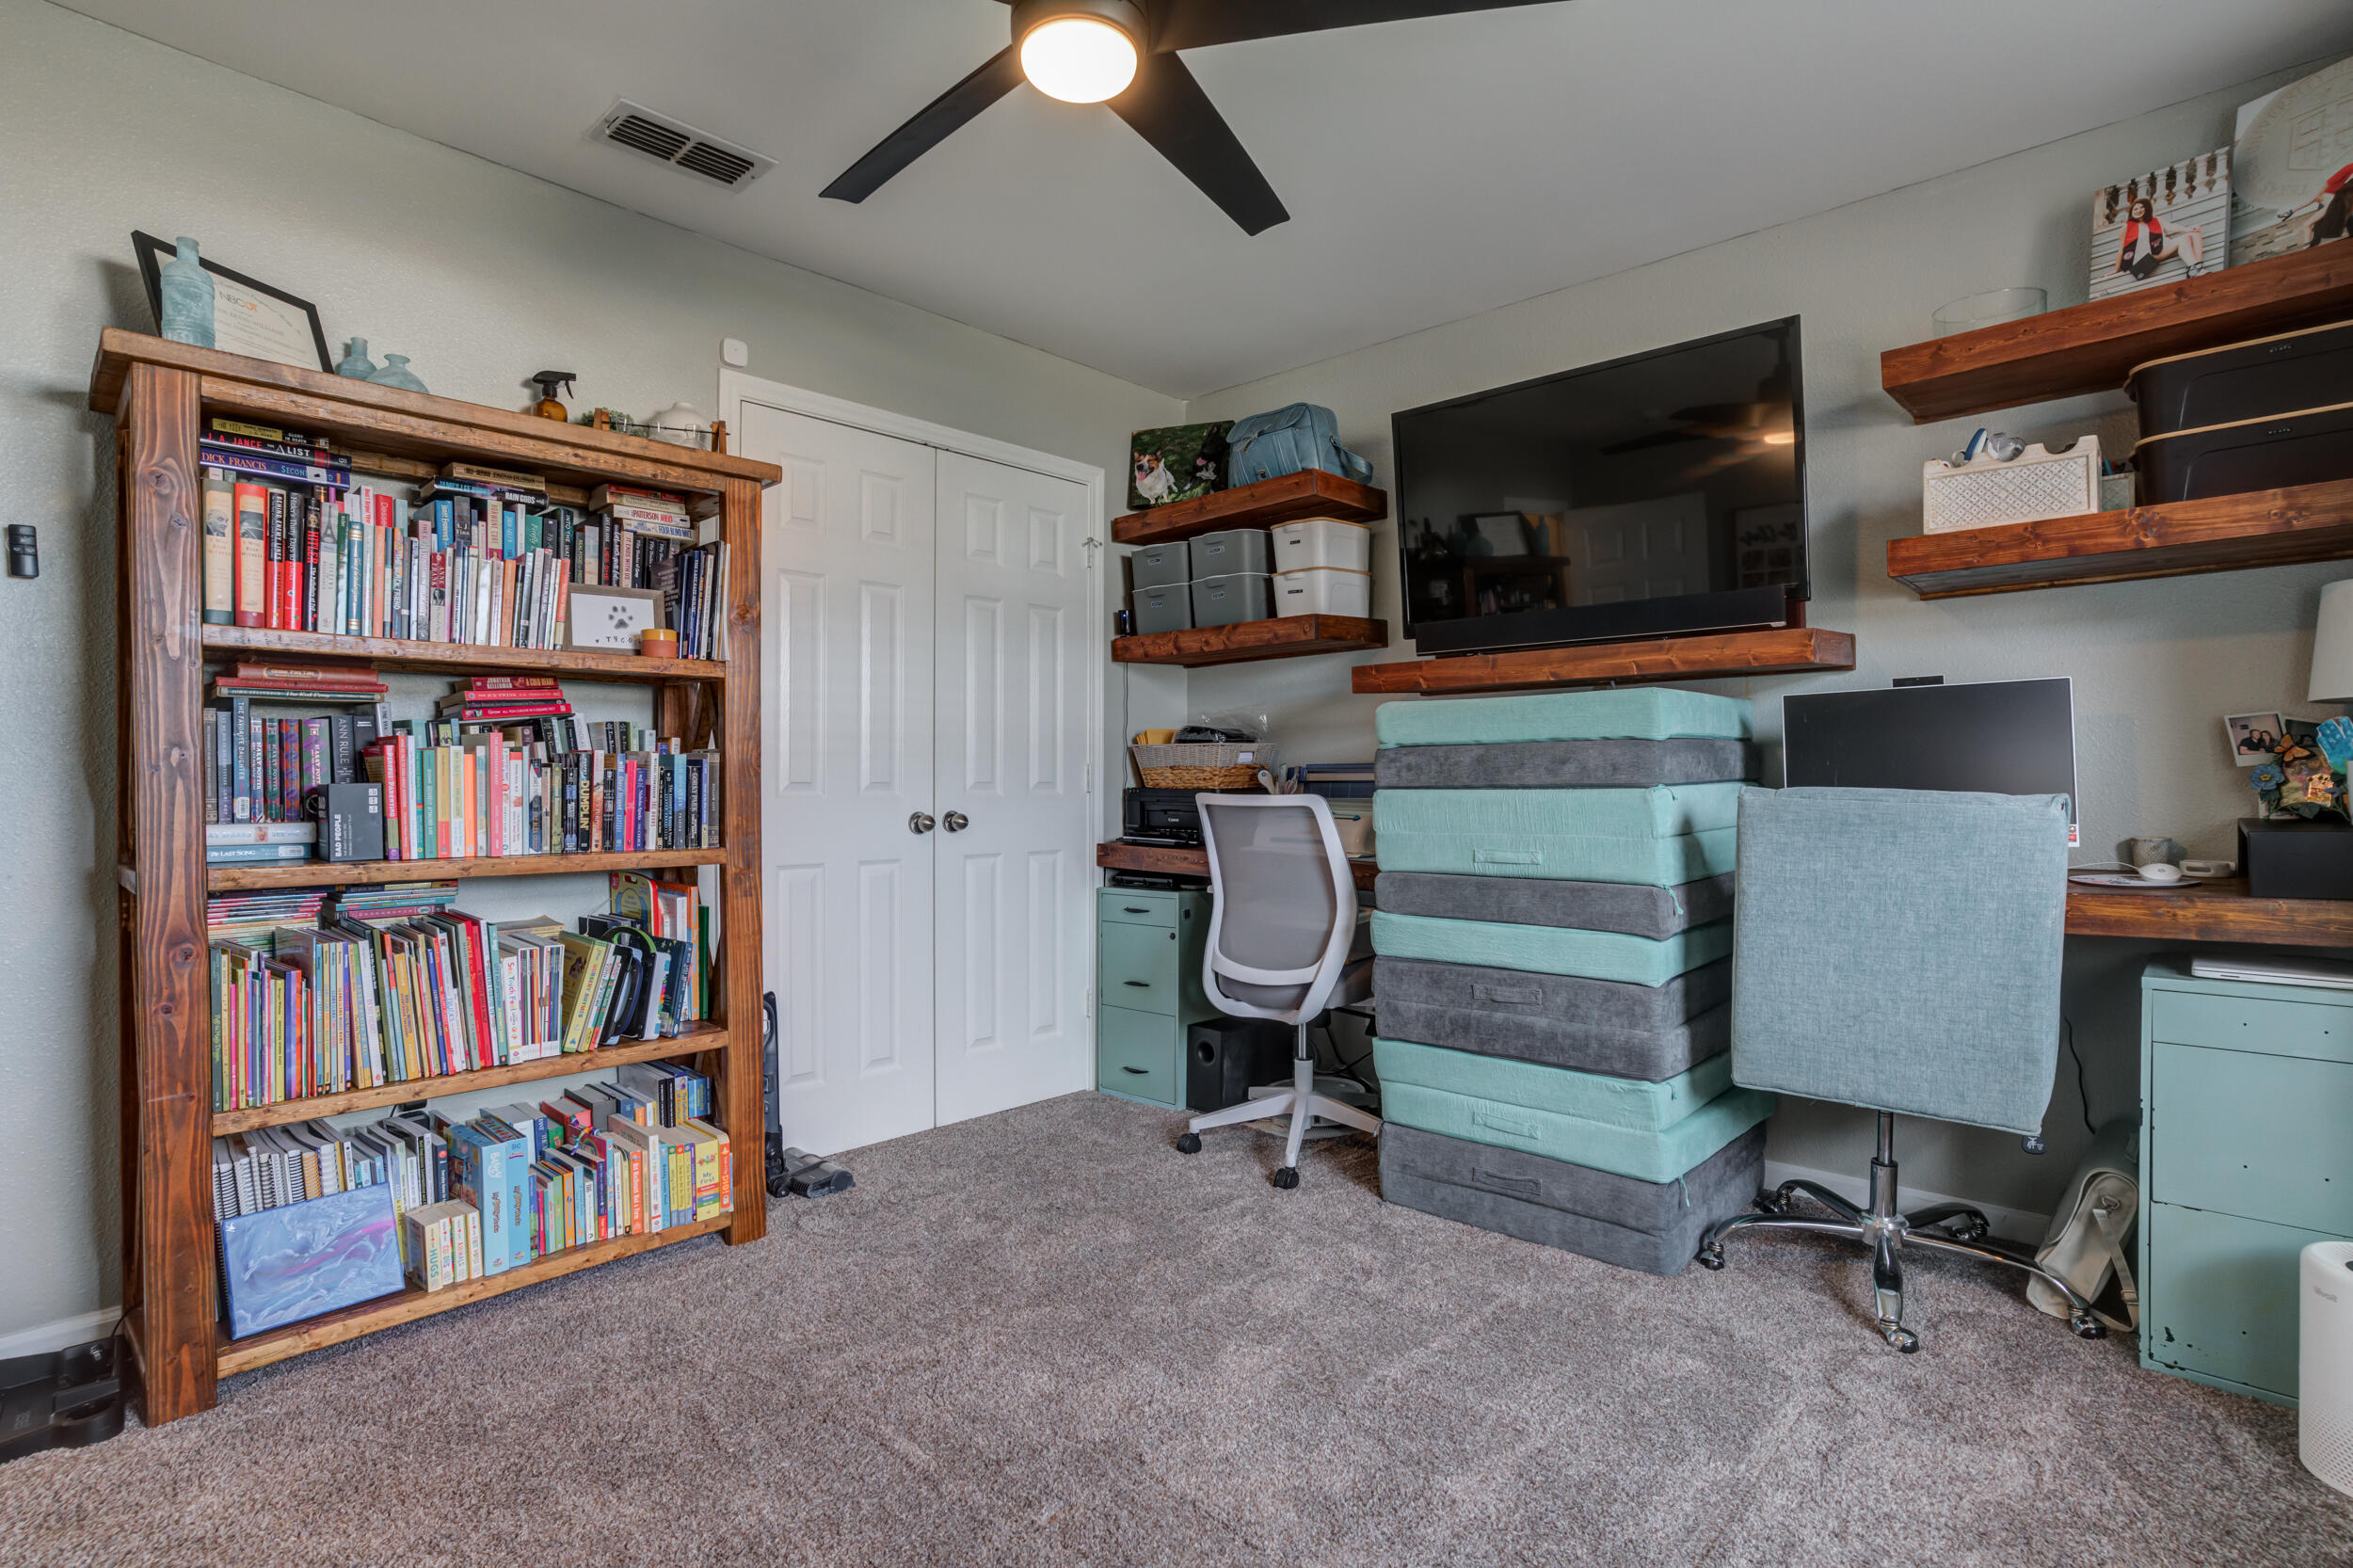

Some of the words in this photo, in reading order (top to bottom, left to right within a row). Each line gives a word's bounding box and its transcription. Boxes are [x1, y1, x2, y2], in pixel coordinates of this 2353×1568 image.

[208, 432, 215, 440] J.
[219, 434, 228, 443] A.
[232, 437, 263, 450] JANCE
[287, 446, 311, 457] LIST
[201, 452, 225, 465] DICK
[229, 456, 267, 471] FRANCIS
[280, 465, 308, 478] SECON
[505, 492, 519, 501] RAIN
[520, 494, 536, 504] GODS
[491, 504, 499, 529] HORMONE
[491, 530, 499, 544] CURE
[658, 526, 670, 534] FOUR
[307, 529, 320, 565] HITLER
[530, 677, 543, 686] COLD
[544, 677, 554, 686] HEART
[338, 718, 347, 738] ANN
[340, 741, 349, 764] RULE
[580, 780, 589, 830] DUMPLIN'
[334, 814, 342, 840] PEOPLE
[220, 849, 236, 857] LAST
[334, 840, 342, 857] BAD
[507, 961, 515, 974] See
[586, 963, 598, 991] NURSERY
[508, 976, 516, 995] Touch
[577, 993, 590, 1018] RHYMES
[429, 1248, 439, 1279] HUGS
